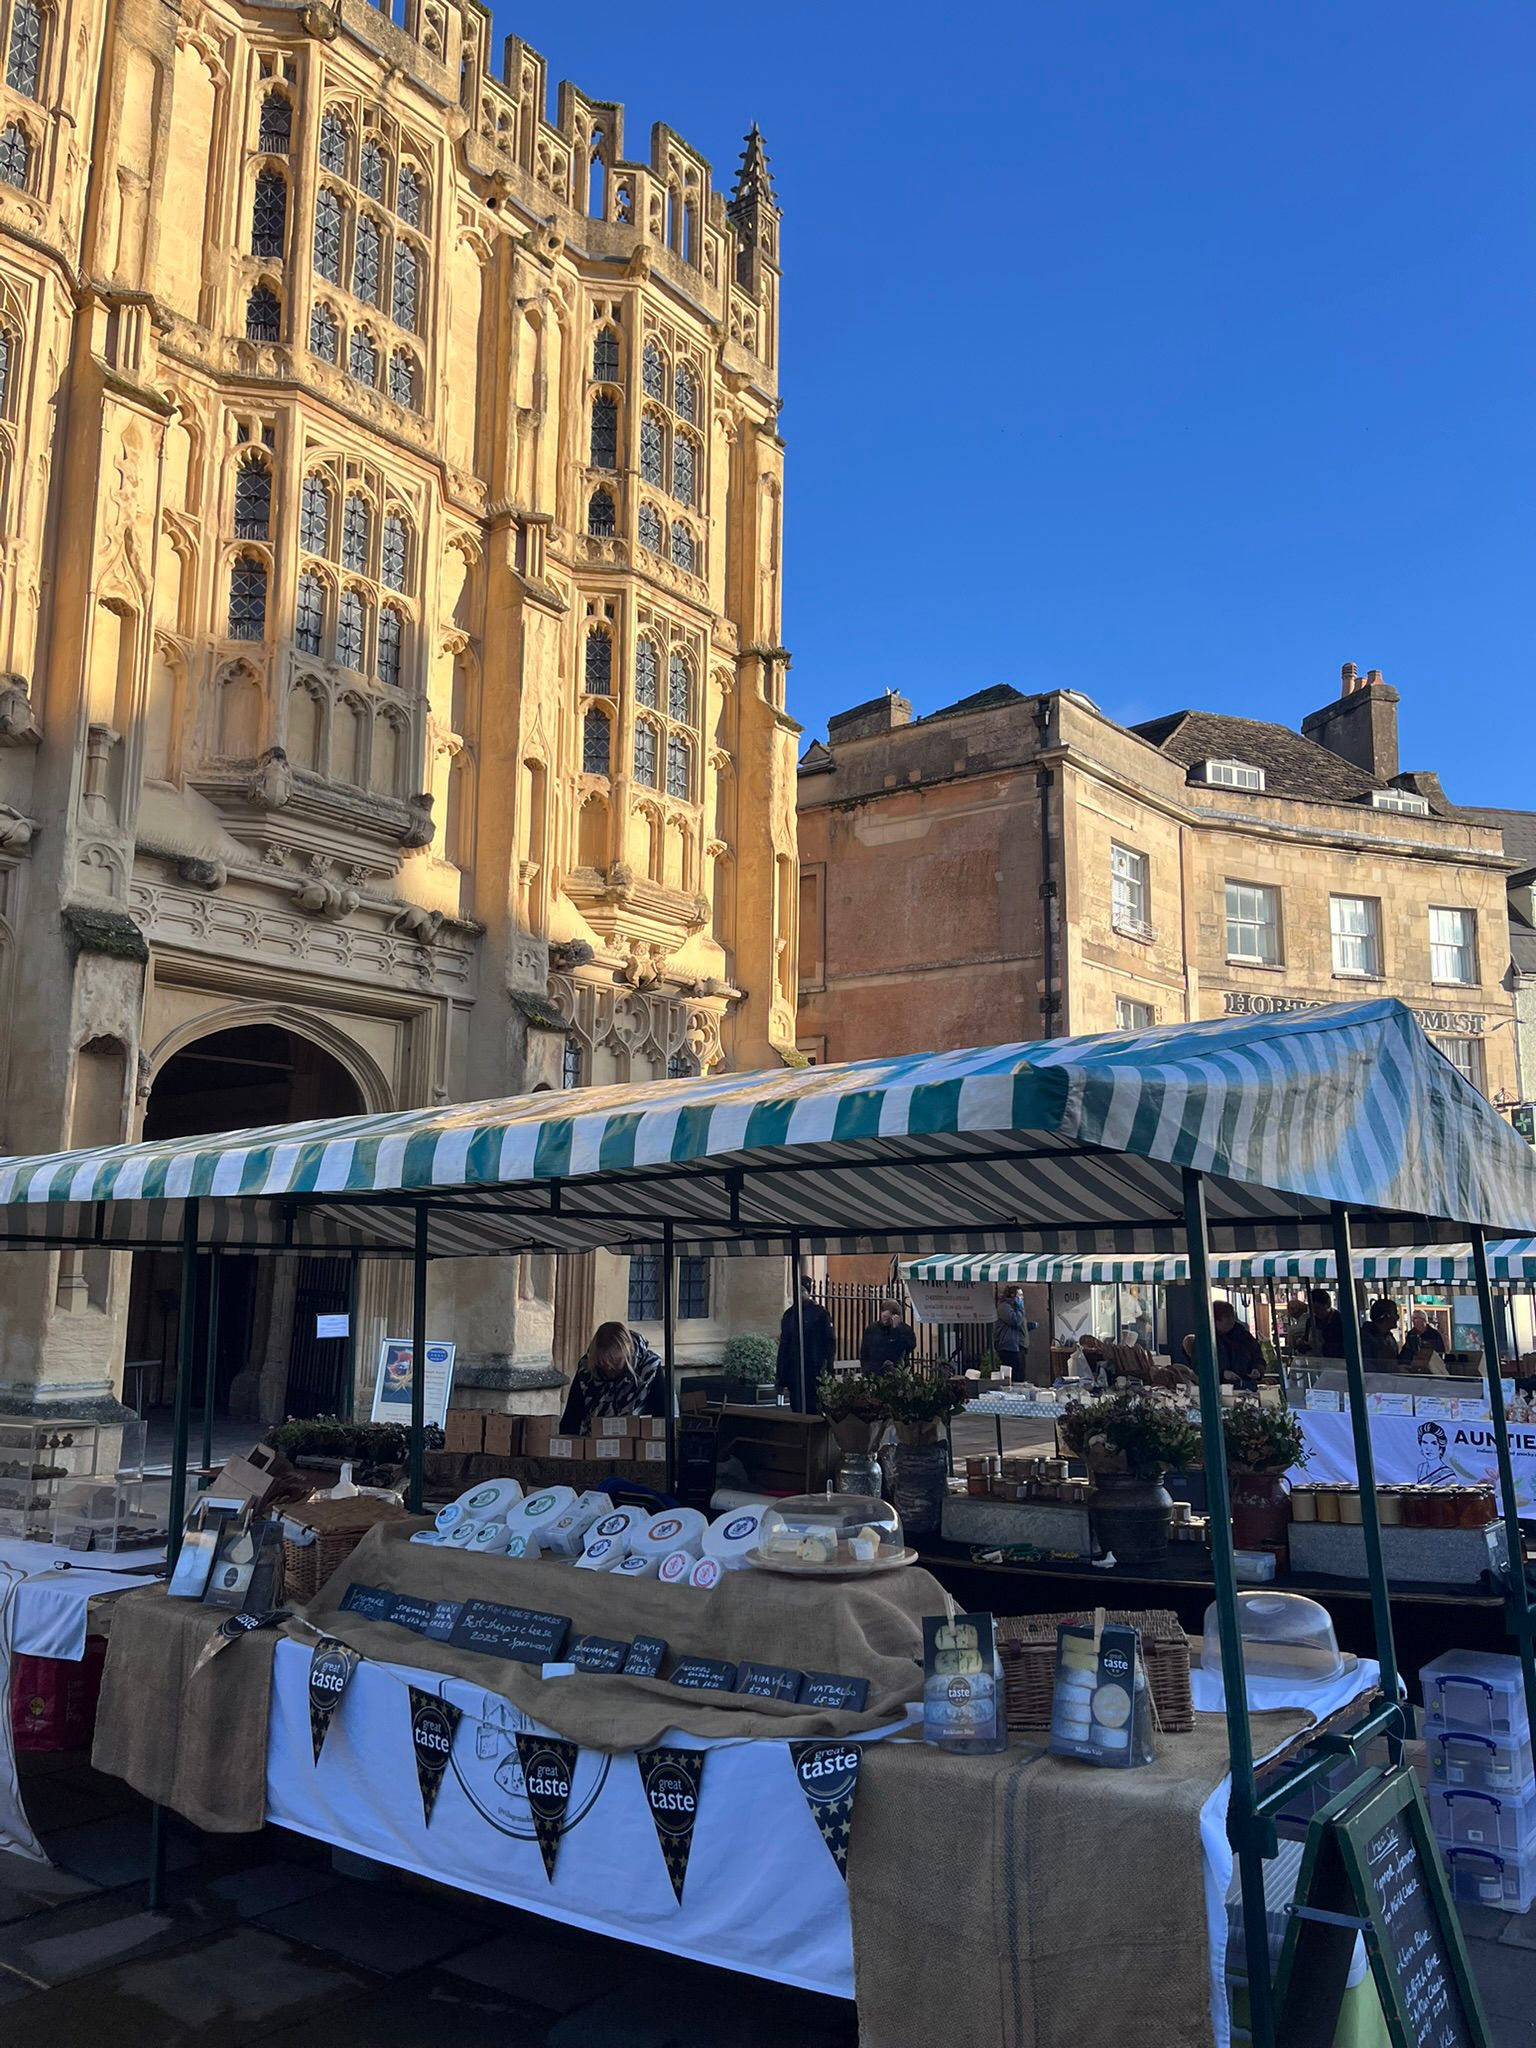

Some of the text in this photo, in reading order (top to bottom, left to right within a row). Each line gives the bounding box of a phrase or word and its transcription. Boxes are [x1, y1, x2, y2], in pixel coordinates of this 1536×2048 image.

[321, 1662, 341, 1674] great
[1103, 1658, 1129, 1671] taste
[311, 1669, 344, 1692] taste
[948, 1688, 971, 1698] taste
[422, 1719, 442, 1733] great
[415, 1726, 449, 1753] taste
[813, 1746, 846, 1761] great
[537, 1765, 559, 1778] great
[801, 1752, 858, 1780] taste
[528, 1775, 569, 1798] taste
[658, 1779, 682, 1792] great
[650, 1789, 695, 1812] taste
